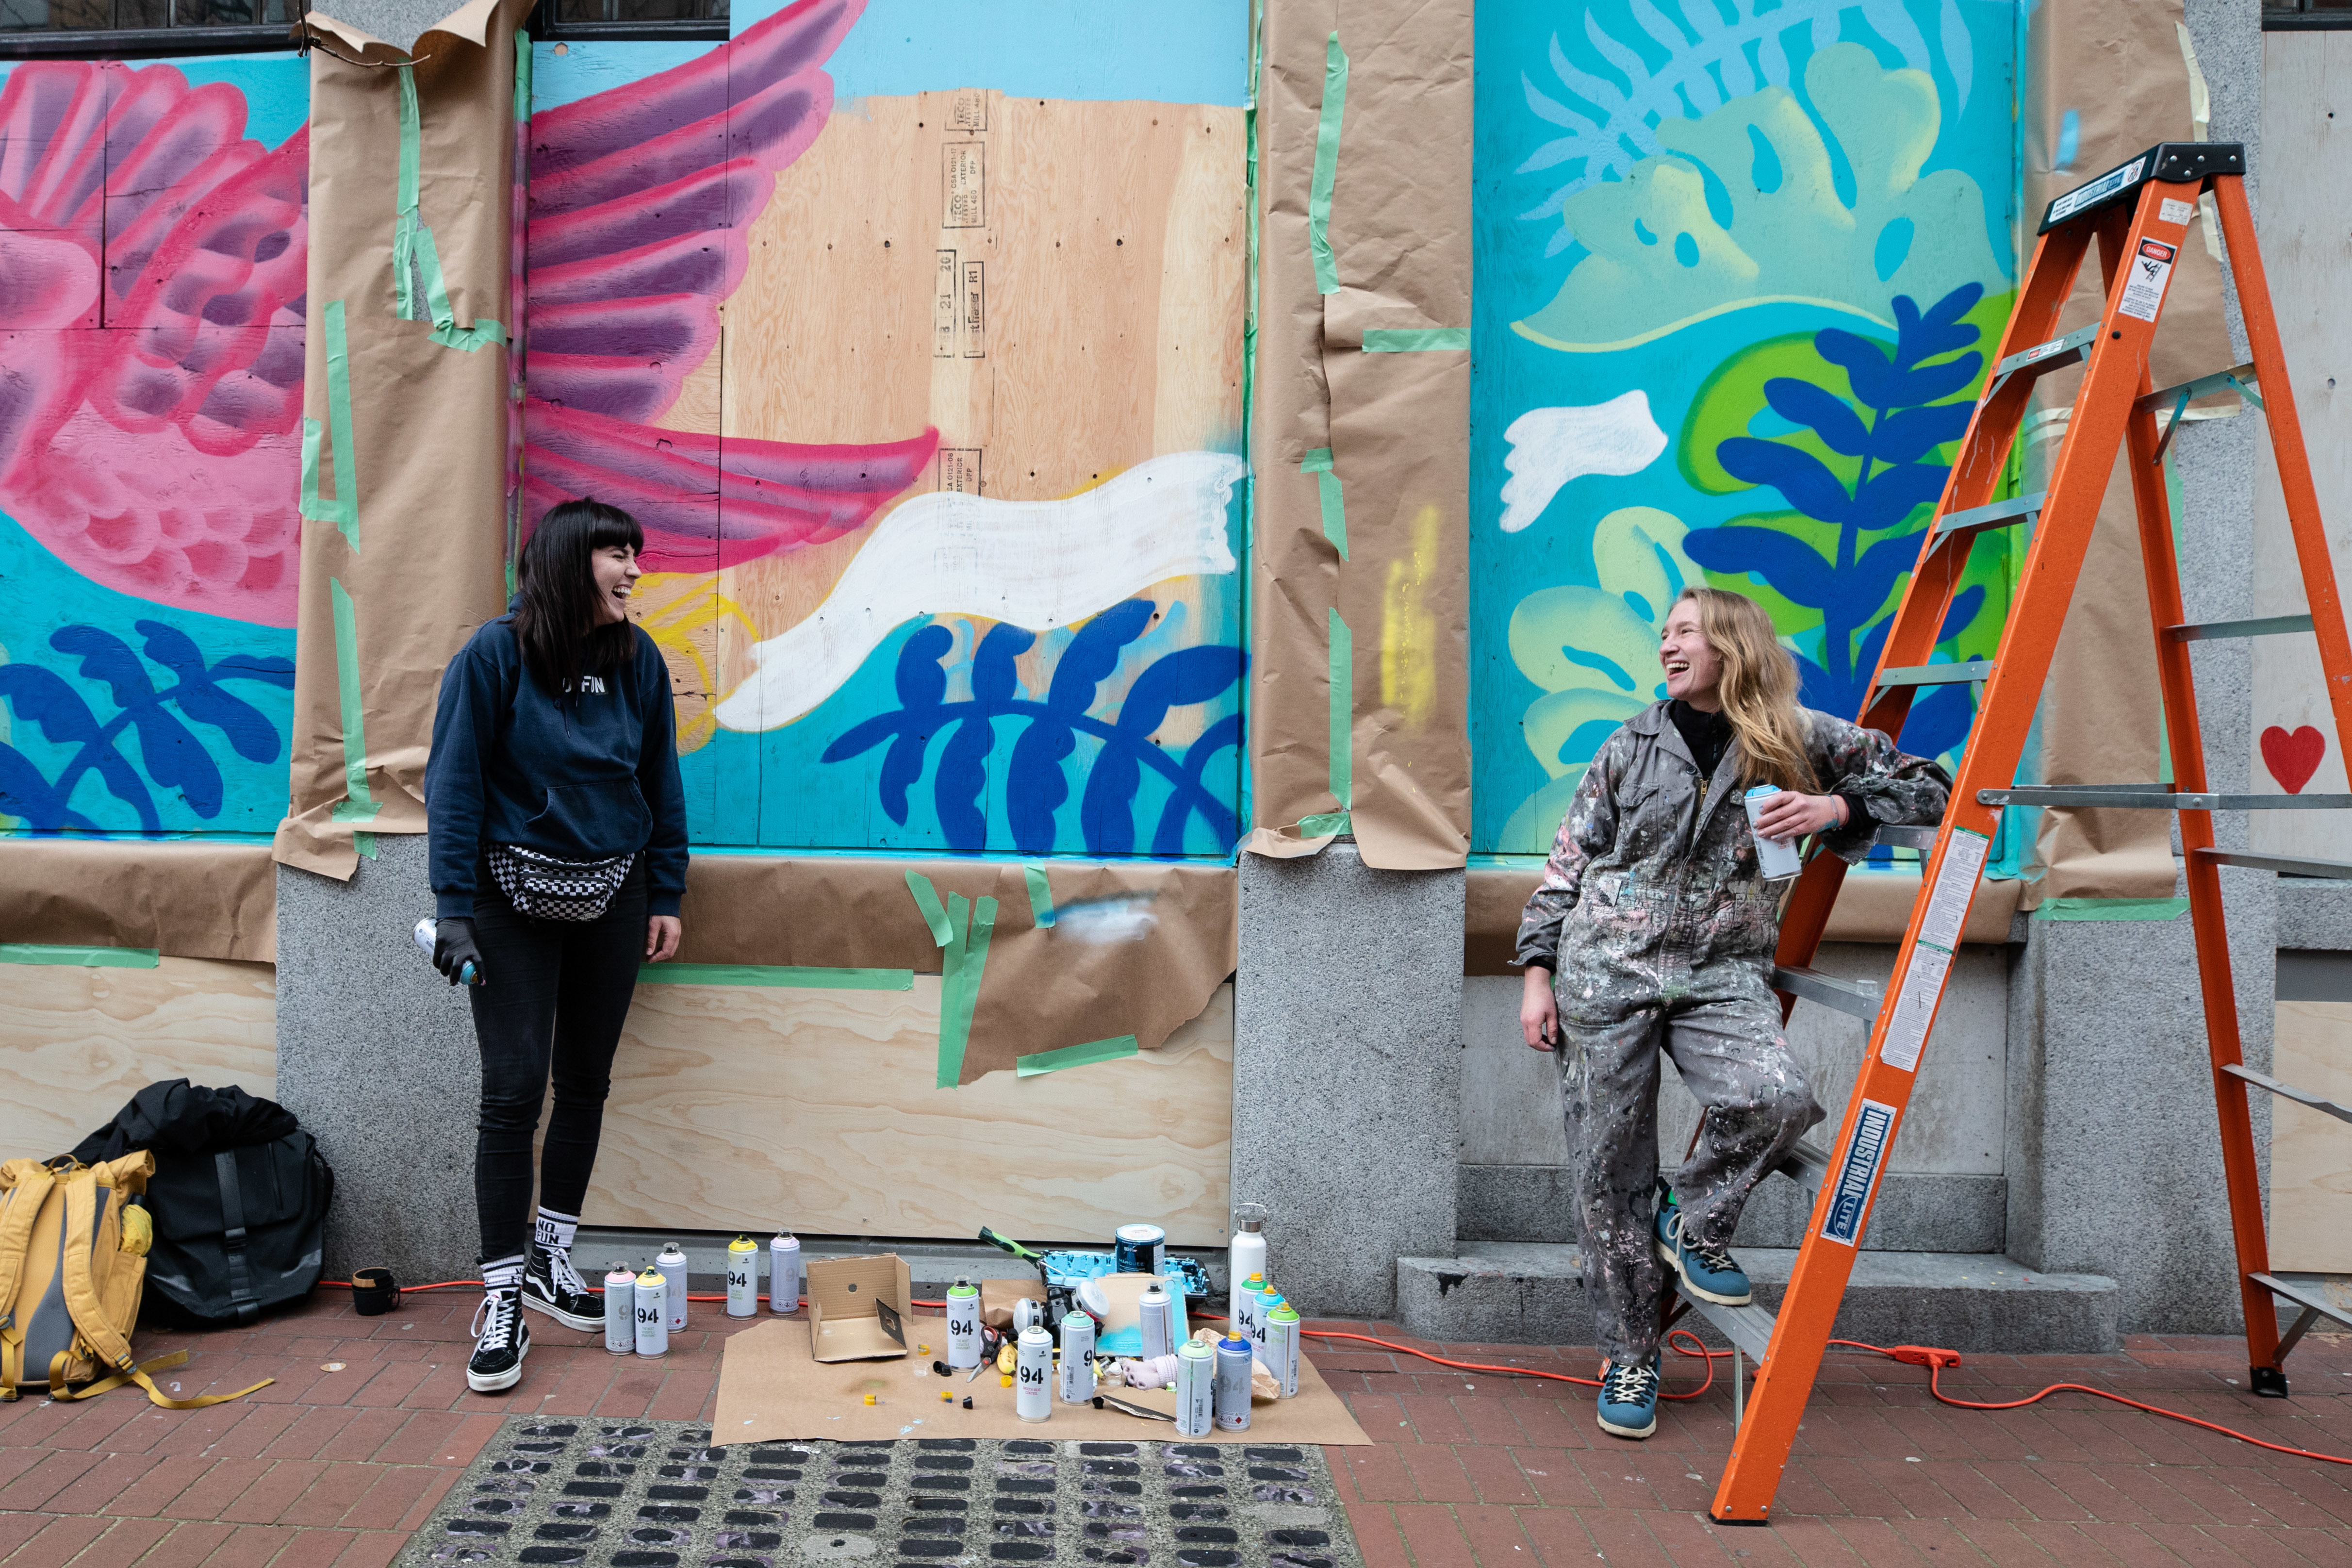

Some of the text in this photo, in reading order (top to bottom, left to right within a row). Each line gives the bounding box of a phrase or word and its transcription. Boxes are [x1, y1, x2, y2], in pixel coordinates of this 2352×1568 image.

[2146, 246, 2168, 258] DANGER
[939, 257, 952, 272] 20
[968, 270, 978, 283] R1
[939, 294, 951, 309] 21
[581, 675, 606, 693] FUN
[1837, 1109, 1889, 1230] INDUSTRIAL LITE
[538, 1219, 556, 1233] NO
[537, 1230, 559, 1244] FUN
[728, 1270, 747, 1287] 94
[637, 1307, 659, 1323] 94
[1238, 1309, 1252, 1328] 94
[951, 1319, 973, 1336] 94
[1020, 1365, 1044, 1385] 94
